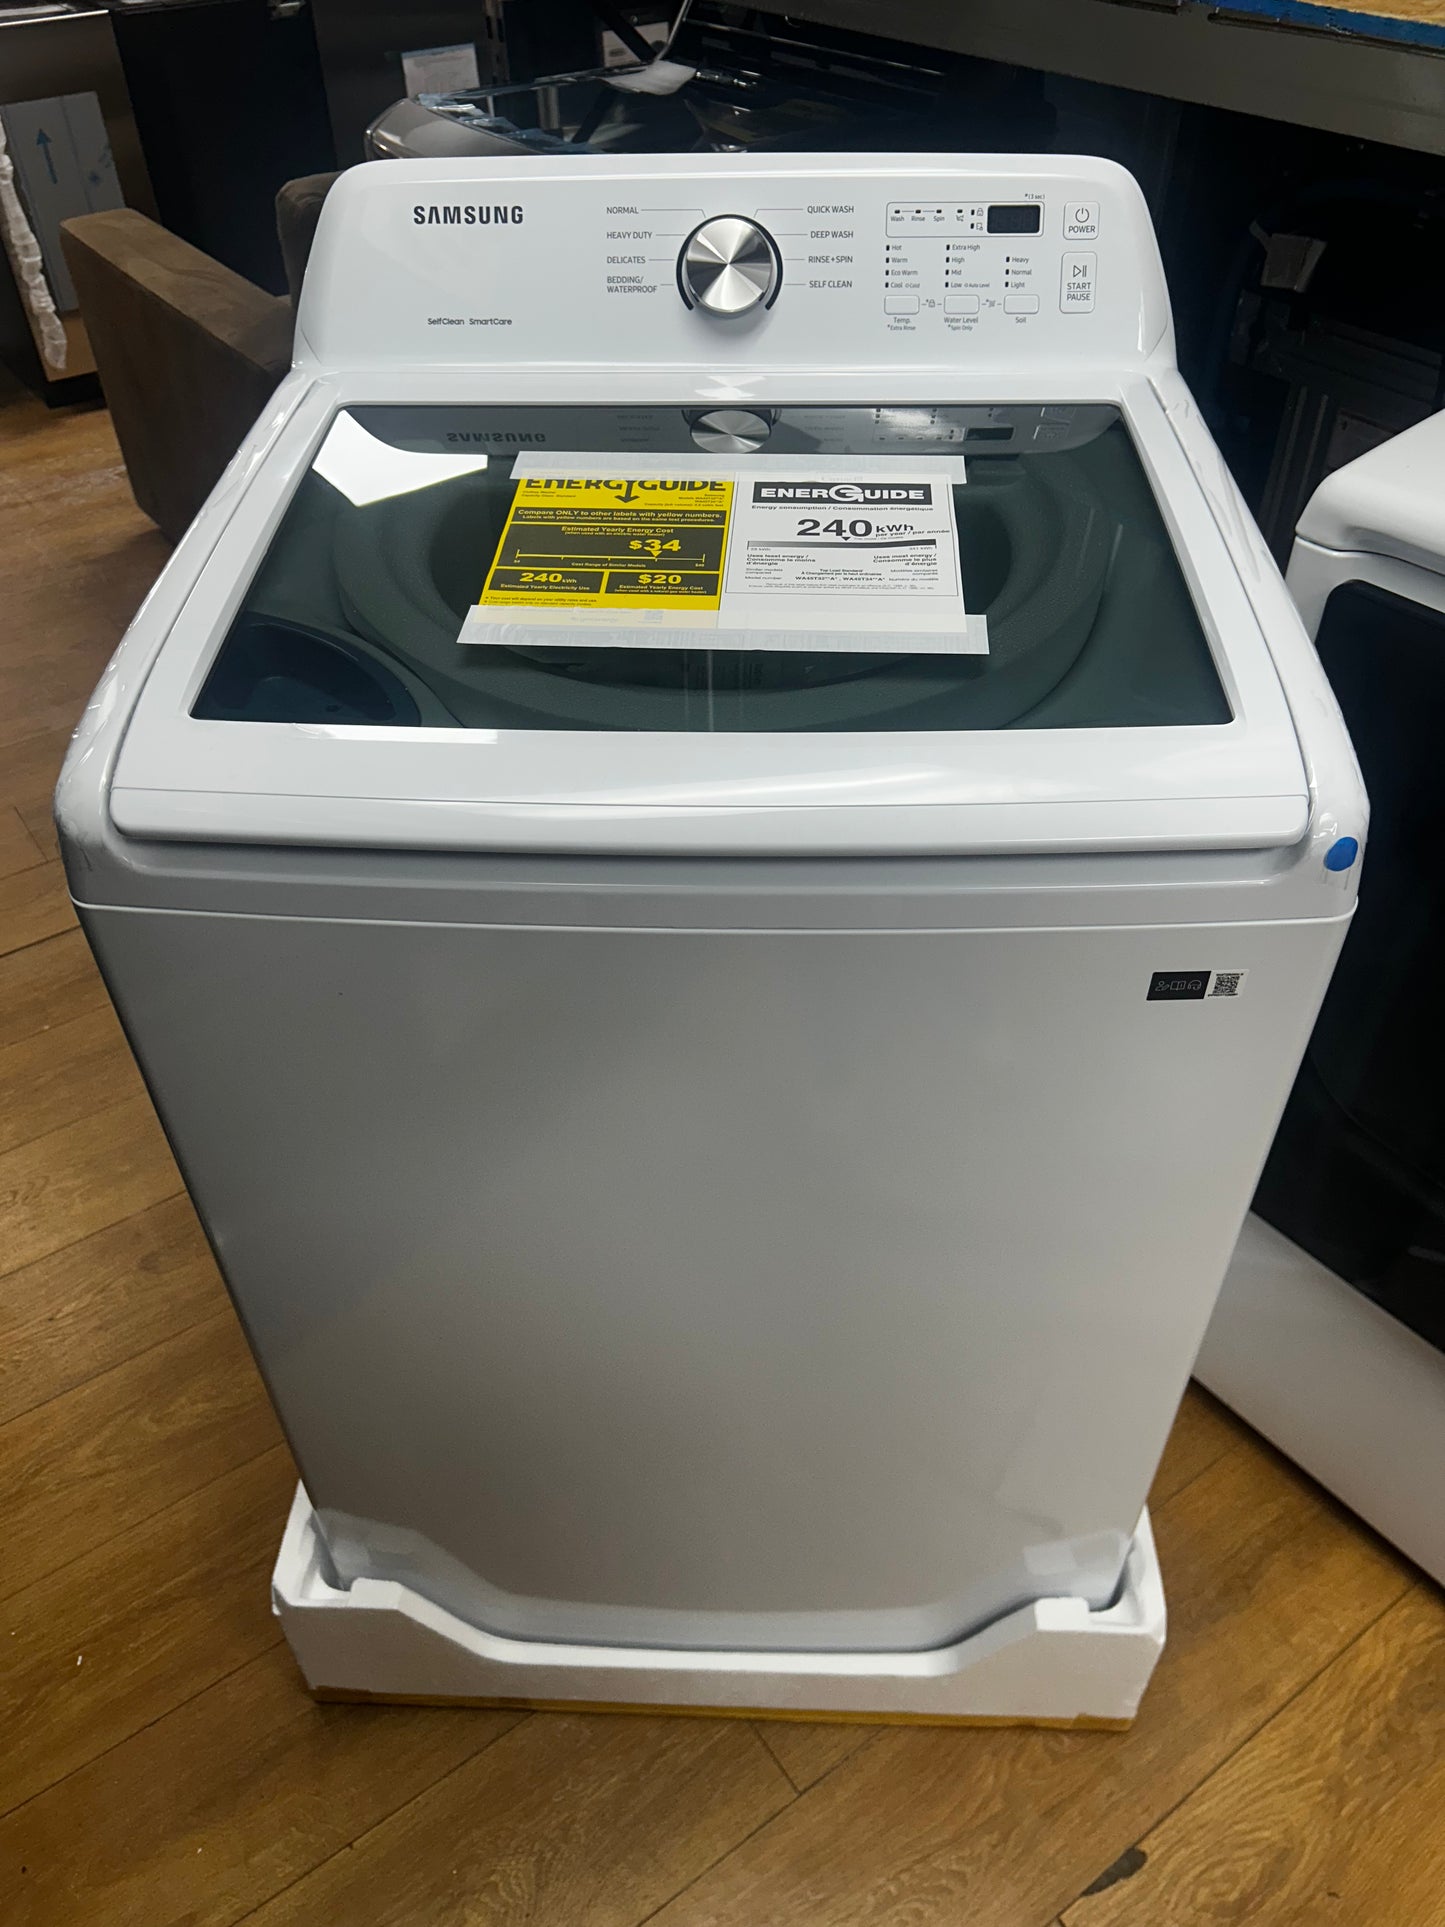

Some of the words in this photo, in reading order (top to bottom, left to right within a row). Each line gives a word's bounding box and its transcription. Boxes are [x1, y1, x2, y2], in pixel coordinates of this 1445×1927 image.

[606, 206, 639, 214] NORMAL
[807, 205, 830, 214] QUICK
[831, 205, 854, 214] WASH
[413, 205, 524, 225] SAMSUNG
[933, 215, 945, 223] Spin
[1068, 225, 1096, 233] POWER
[606, 231, 632, 239] HEAVY
[632, 231, 653, 239] DUTY
[810, 230, 830, 239] DEEP
[831, 230, 854, 239] WASH
[967, 244, 980, 252] High
[606, 256, 646, 264] DELICATES
[1011, 256, 1029, 264] Heavy
[606, 276, 644, 285] BEDDING/
[809, 280, 827, 288] SELF
[827, 280, 852, 288] CLEAN
[1010, 281, 1025, 289] Light
[1066, 282, 1091, 290] START
[606, 285, 657, 294] WATERPROOF
[1066, 293, 1091, 301] PAUSE
[427, 317, 465, 326] SelfClean
[469, 317, 512, 326] SmartCare
[1015, 316, 1027, 324] Soil
[518, 509, 554, 517] Compare
[797, 519, 873, 537] 240
[876, 523, 914, 533] kWh
[628, 539, 682, 552] $34
[519, 572, 563, 583] 240
[638, 574, 682, 585] $20
